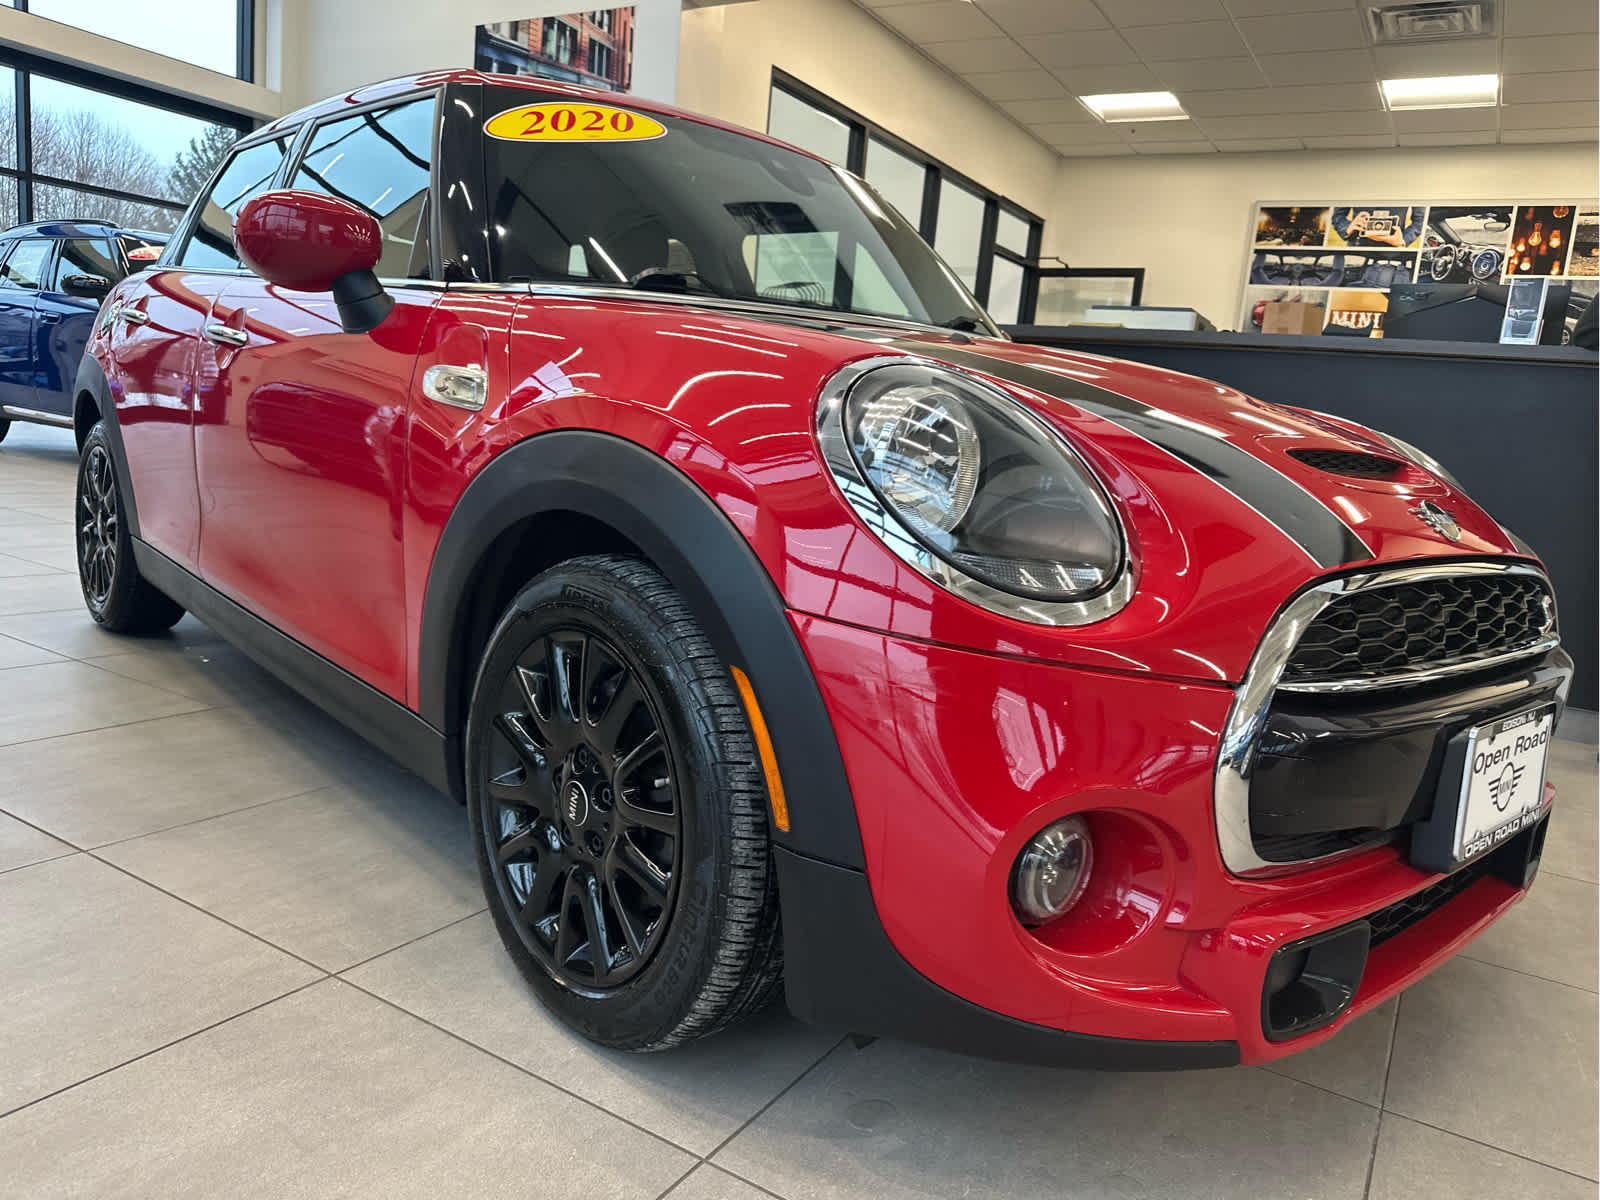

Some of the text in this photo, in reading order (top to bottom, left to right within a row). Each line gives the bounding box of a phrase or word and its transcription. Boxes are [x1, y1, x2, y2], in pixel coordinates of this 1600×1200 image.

[520, 109, 635, 136] 2020
[1331, 311, 1382, 329] MINI
[1473, 730, 1548, 775] Open Road
[569, 787, 580, 821] MINI
[1464, 833, 1493, 858] OPEN
[1494, 819, 1520, 843] ROAD
